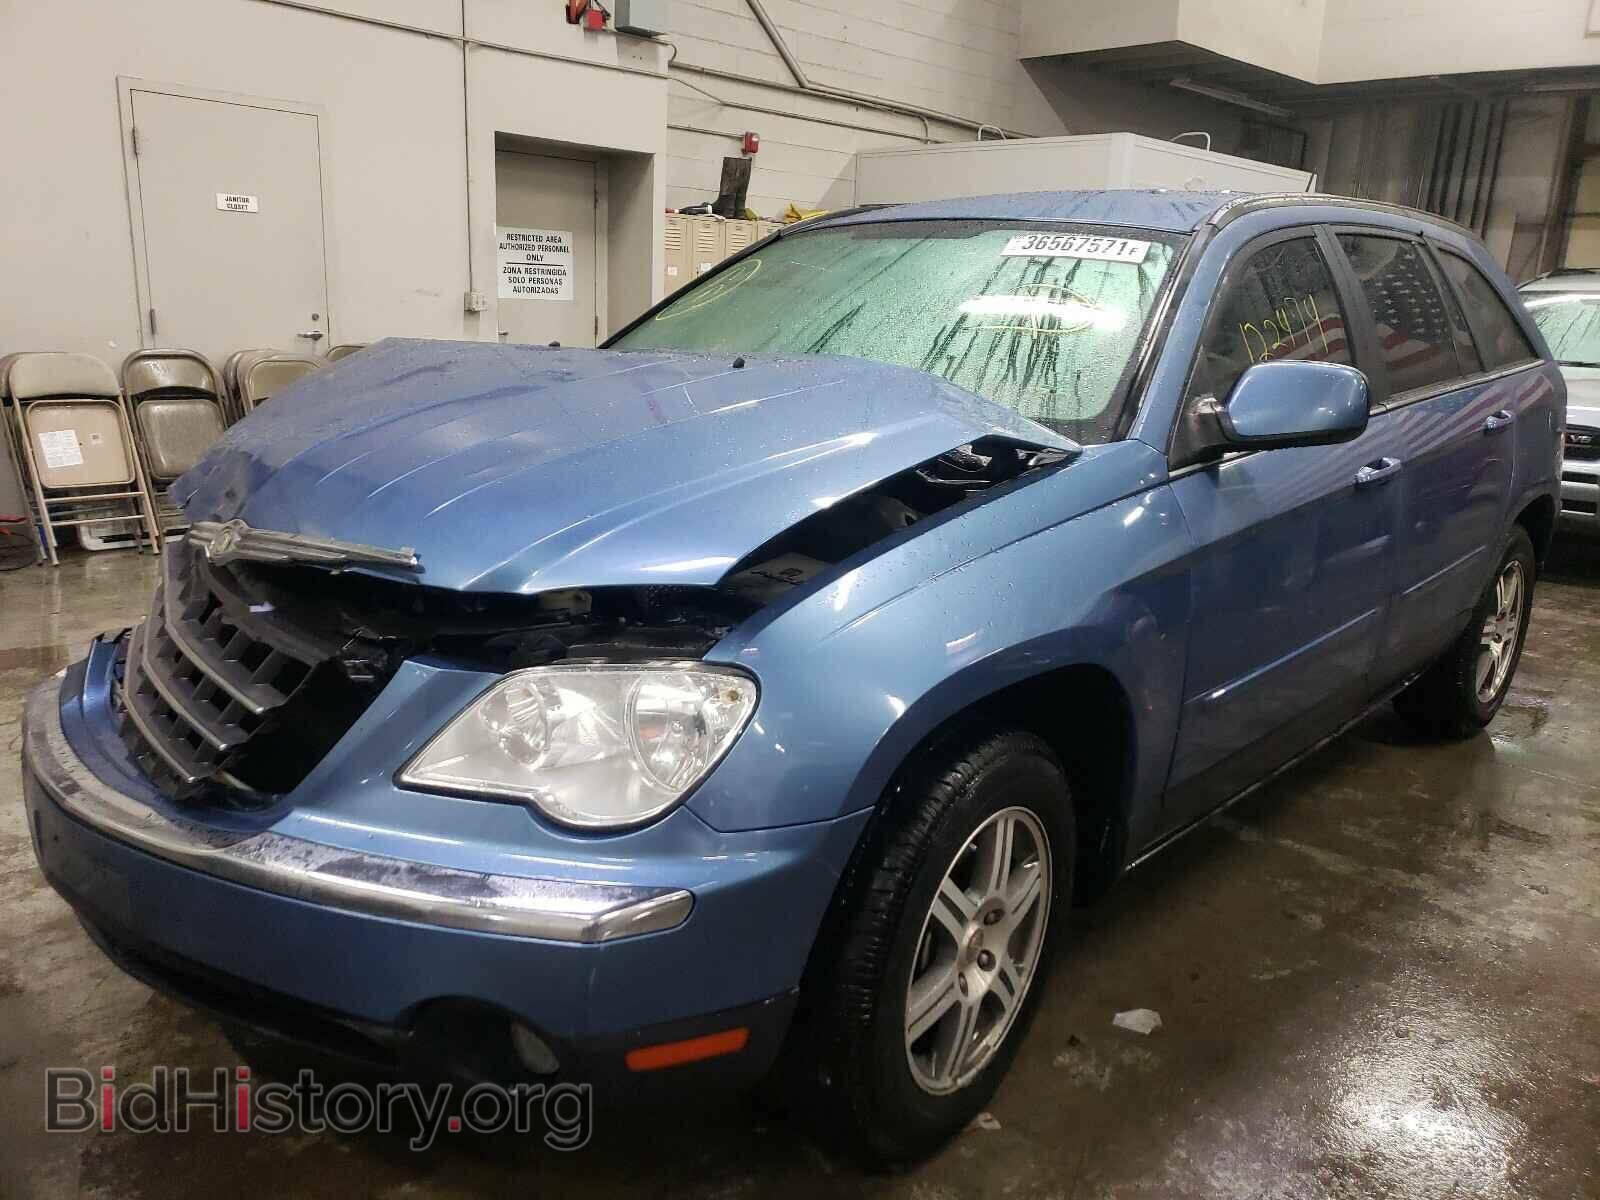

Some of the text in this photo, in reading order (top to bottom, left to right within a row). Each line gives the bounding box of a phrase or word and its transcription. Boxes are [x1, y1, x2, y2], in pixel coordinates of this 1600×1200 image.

[506, 233, 562, 243] RESTRICTED AREA
[499, 242, 569, 253] AUTHORIZED PERSONNEL
[526, 253, 544, 261] ONLY
[503, 266, 567, 276] ZONA RESTRINGIDA
[508, 276, 563, 285] SOLO PERSONAS
[512, 286, 559, 294] AUTORIZADAS
